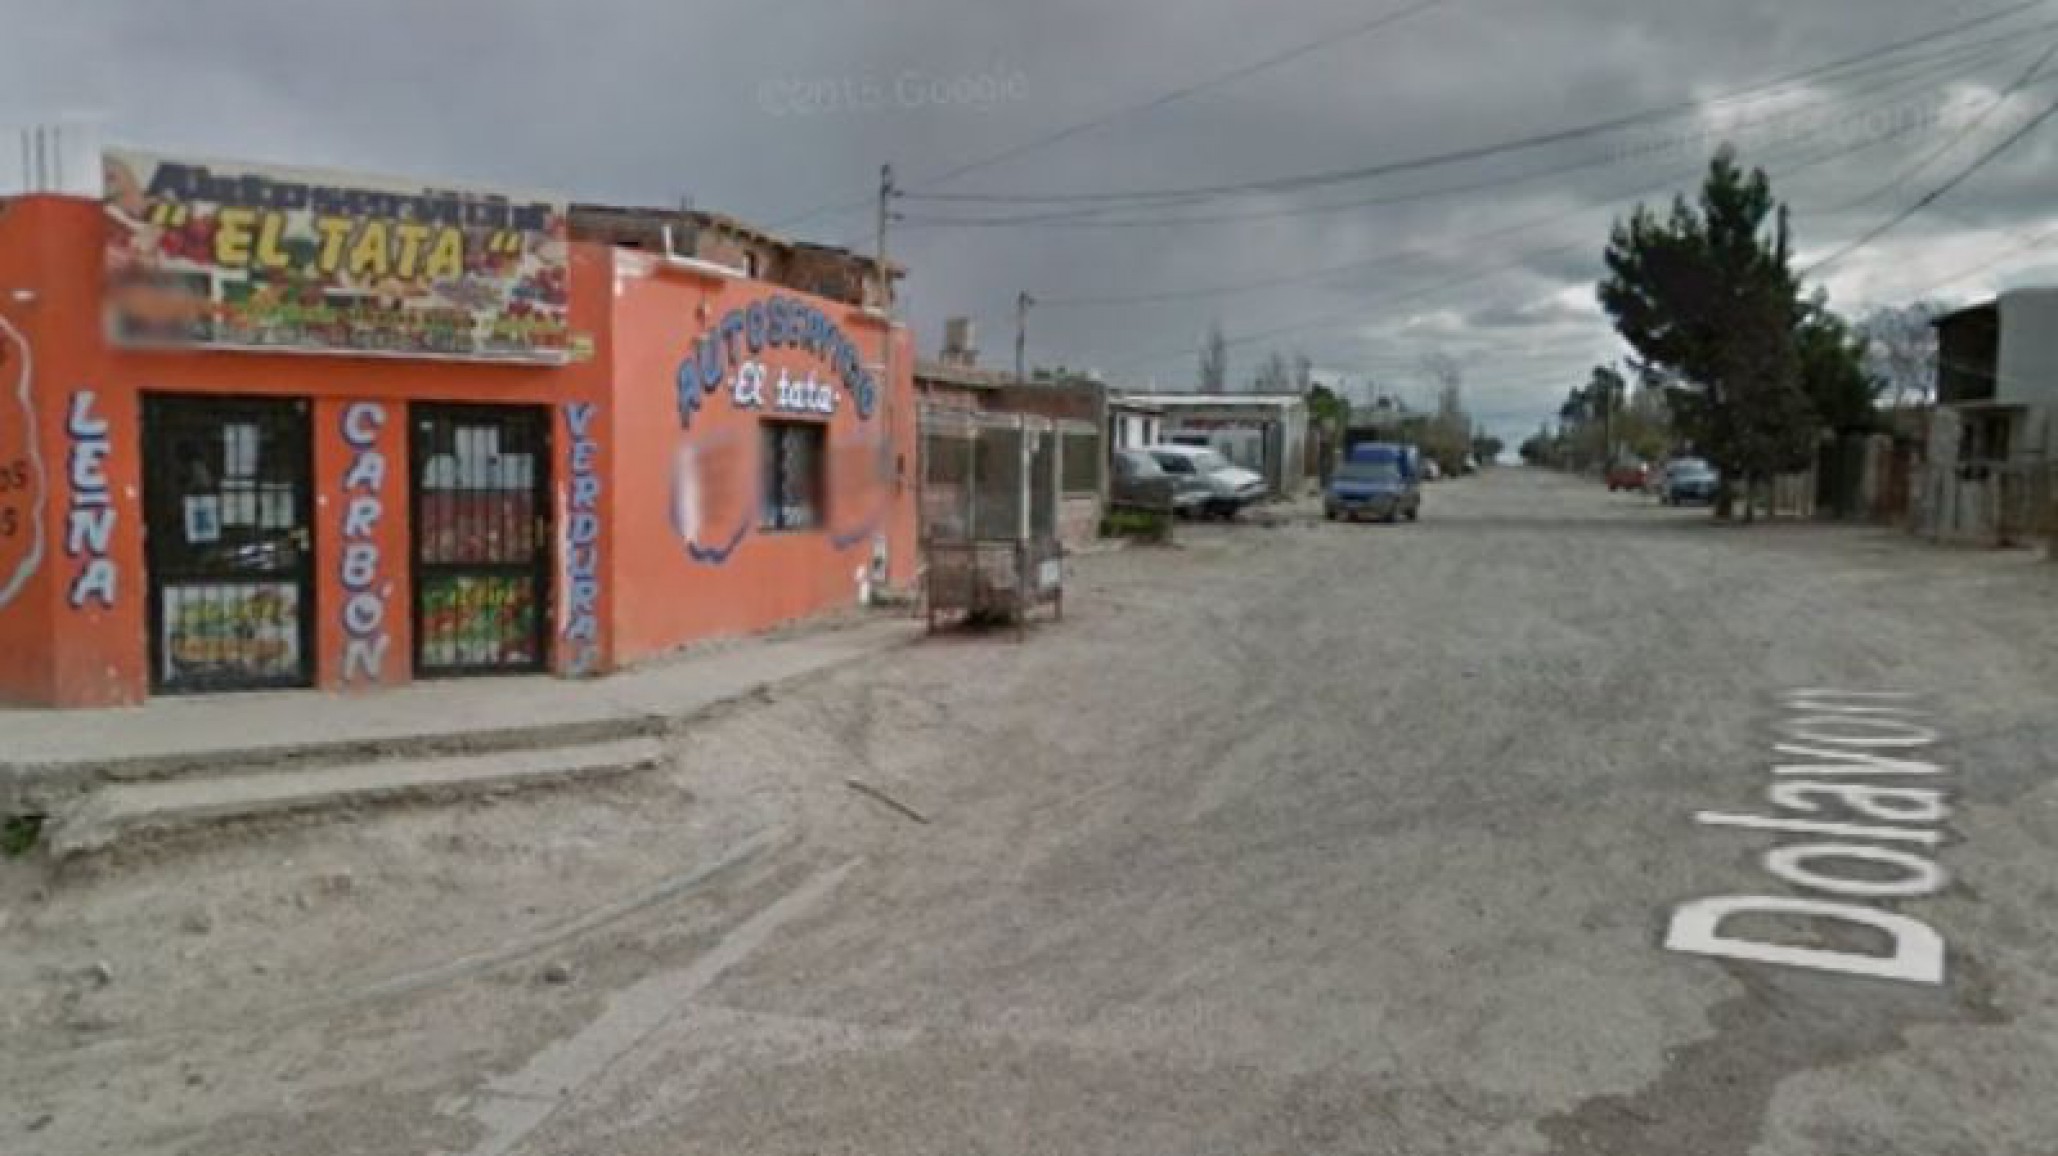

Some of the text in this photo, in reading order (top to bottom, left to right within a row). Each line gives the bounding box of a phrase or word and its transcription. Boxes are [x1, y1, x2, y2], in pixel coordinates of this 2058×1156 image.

[214, 205, 290, 269] EL
[316, 215, 463, 278] TATA
[776, 367, 834, 413] tata
[341, 402, 394, 681] CARBÓN
